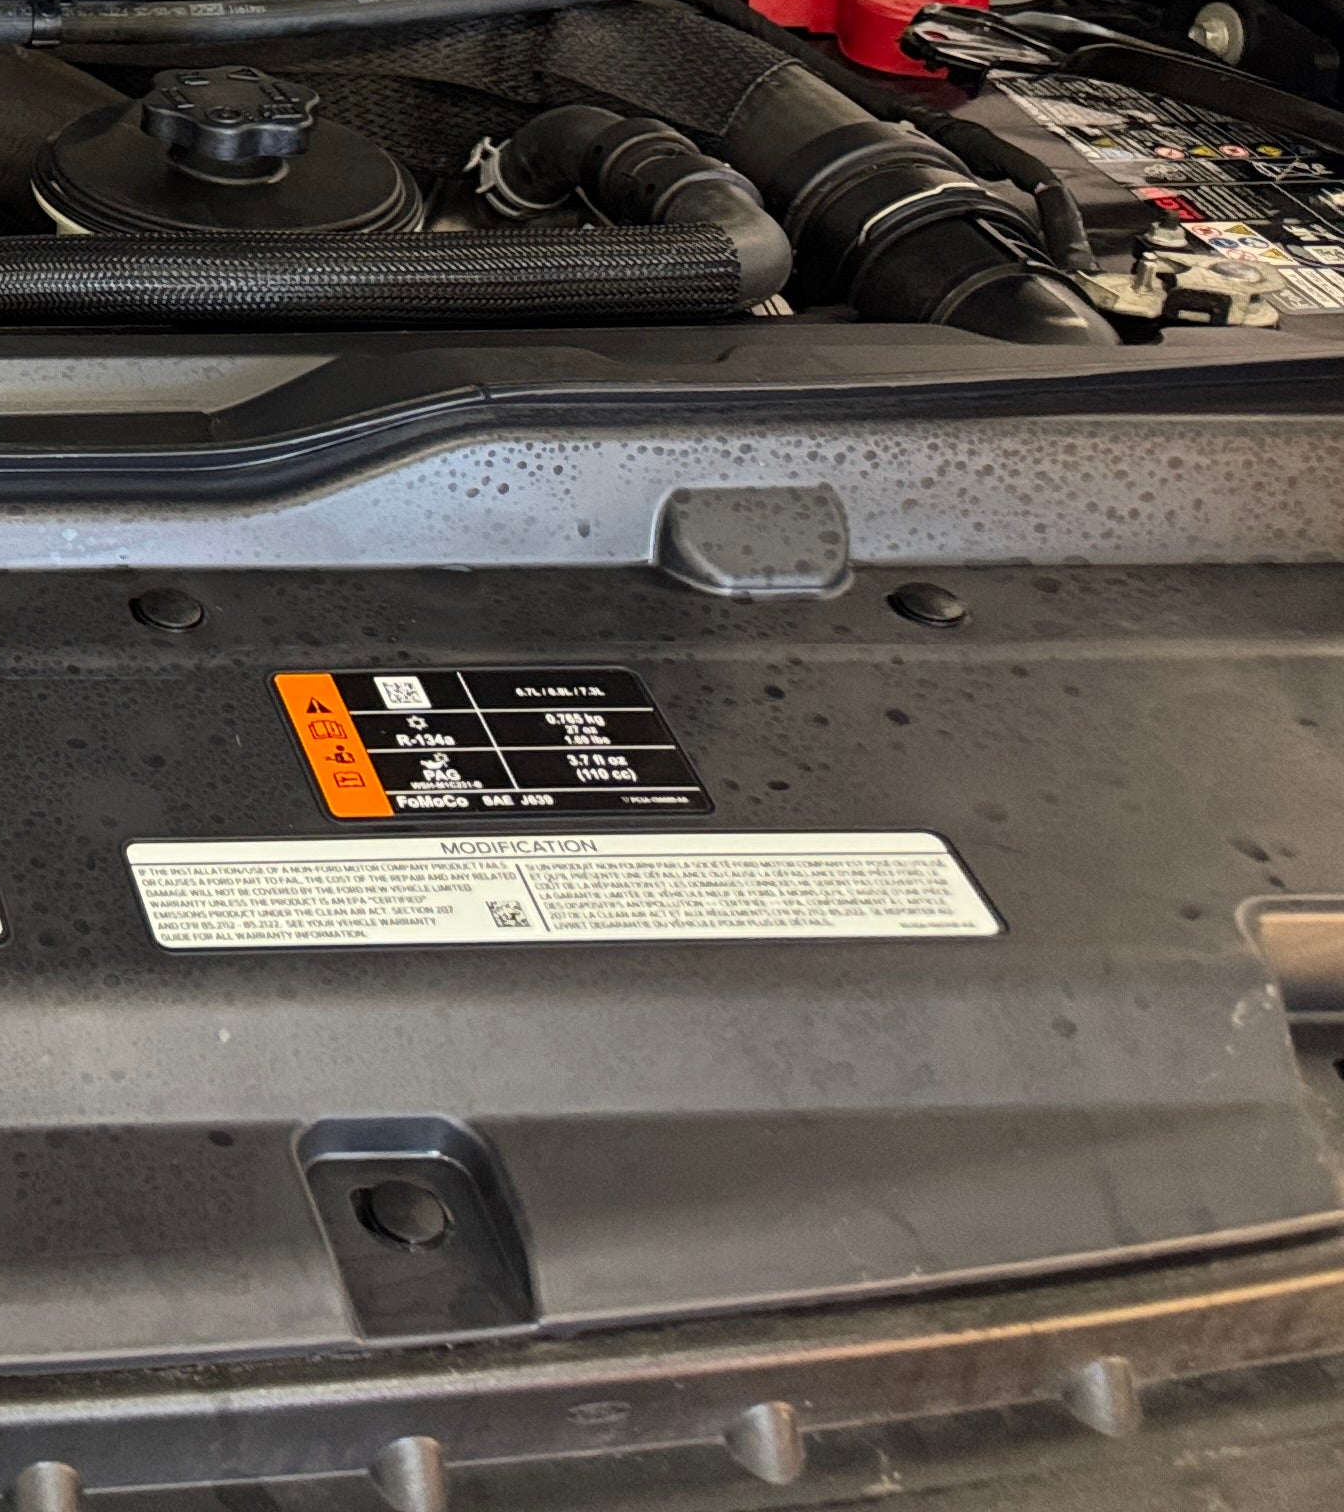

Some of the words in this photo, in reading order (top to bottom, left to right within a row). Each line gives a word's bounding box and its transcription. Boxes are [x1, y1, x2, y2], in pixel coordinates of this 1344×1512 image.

[544, 713, 584, 725] 0.765
[584, 713, 606, 727] kg
[396, 734, 456, 746] R-134a
[566, 754, 589, 766] 3.7
[592, 754, 605, 765] fl
[608, 756, 628, 766] oz
[422, 768, 461, 781] PAG
[576, 769, 610, 783] (110
[612, 768, 637, 783] cc)
[396, 795, 470, 808] FoMoCo
[482, 795, 515, 806] SAE
[520, 795, 554, 806] J639
[440, 838, 598, 855] MODIFICATION
[289, 865, 342, 873] NON-FORD
[389, 874, 425, 882] REPAIR
[145, 889, 186, 897] DAMAGE
[252, 887, 298, 895] COVERED
[306, 919, 334, 927] YOUR
[235, 931, 293, 939] WARRANTY
